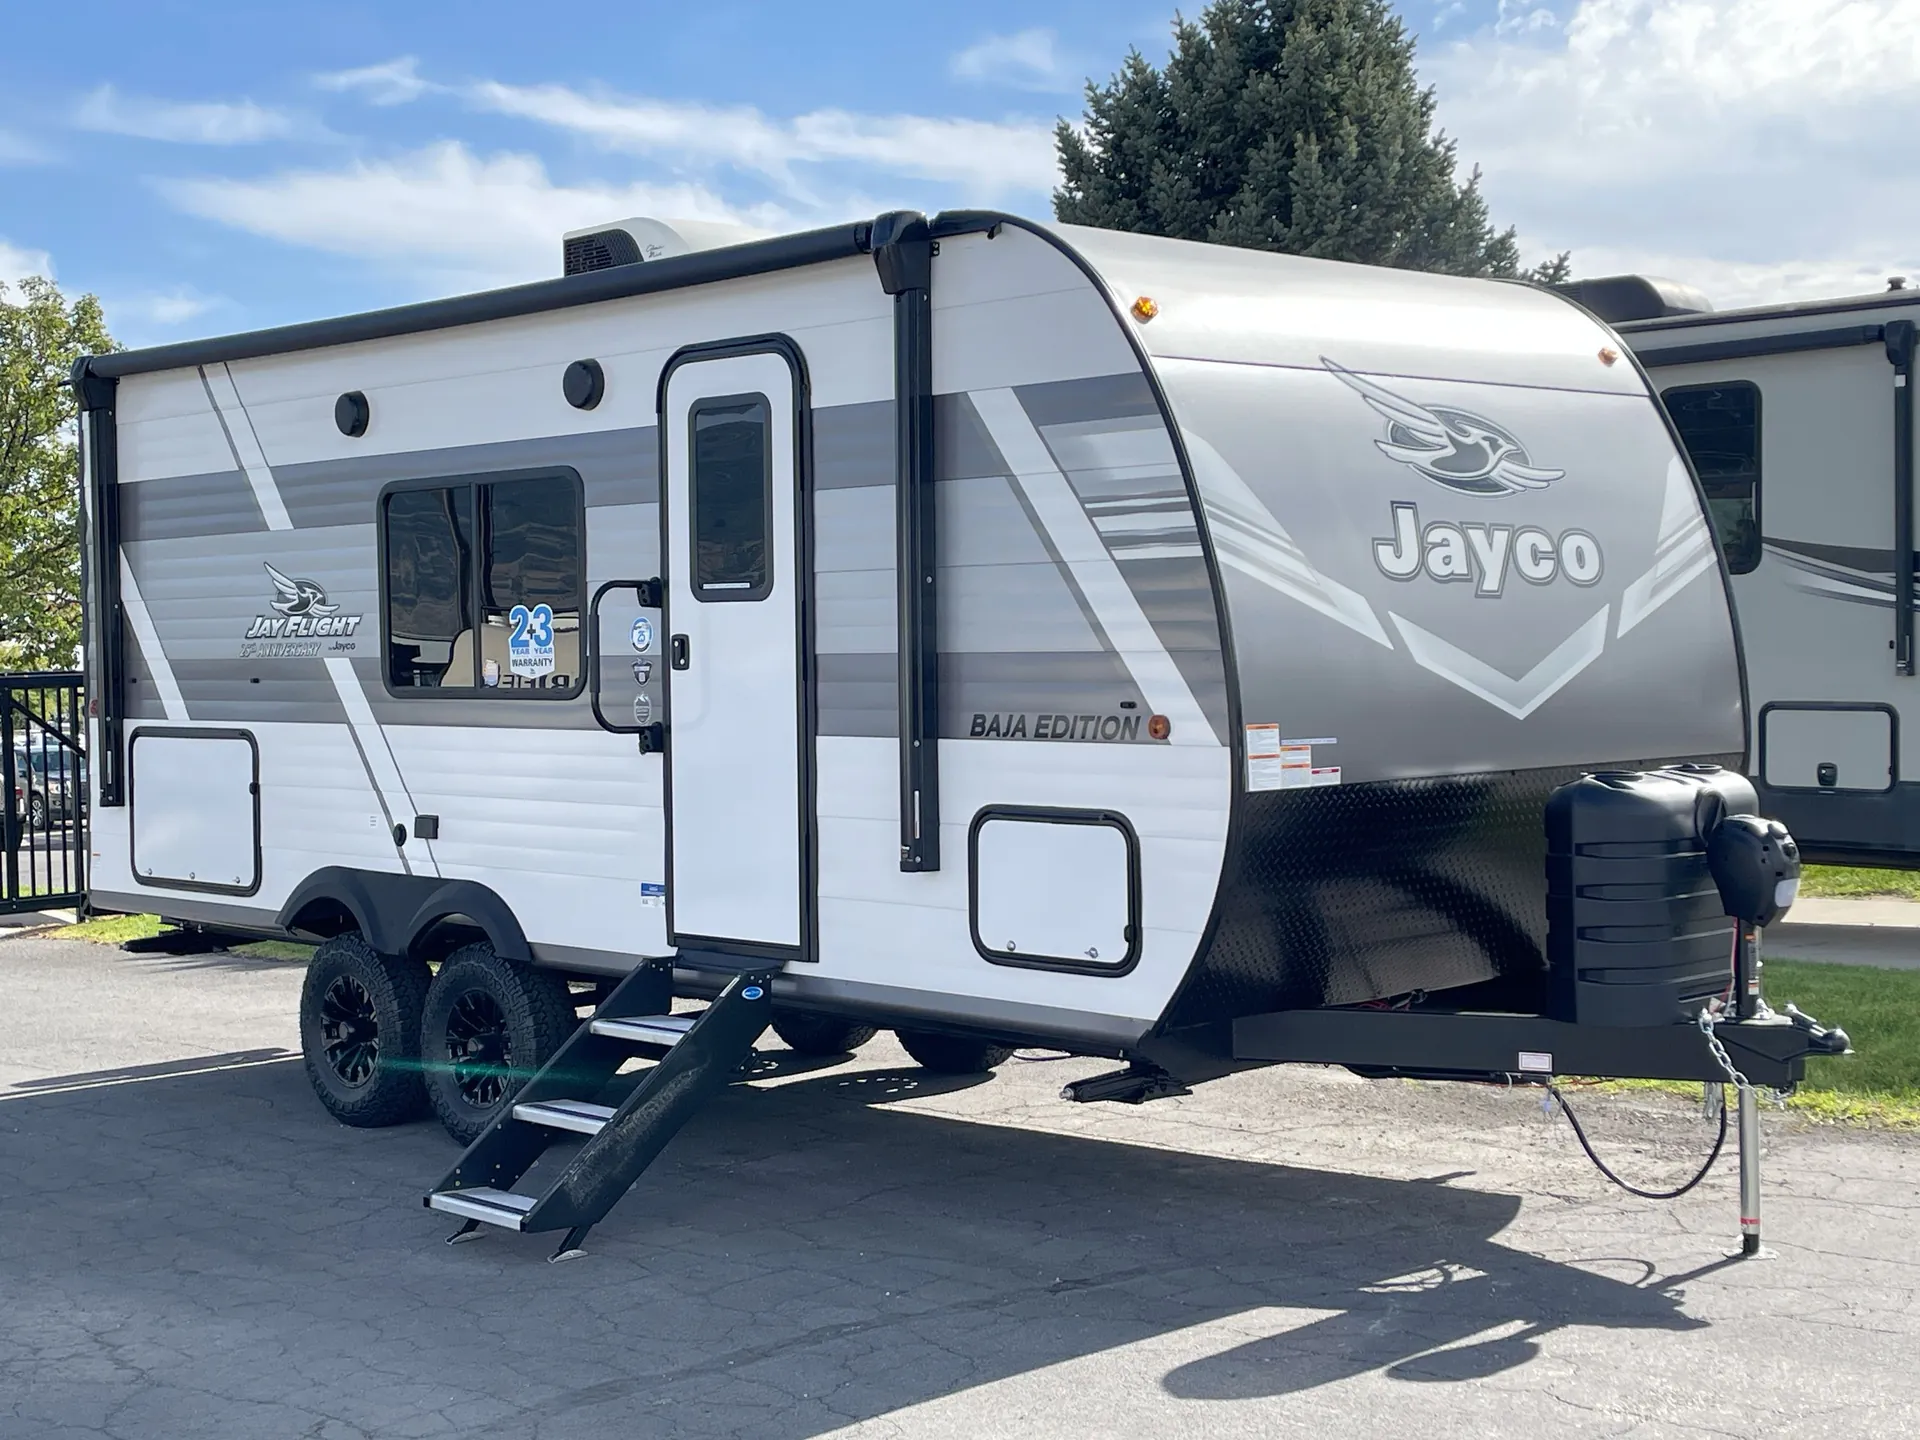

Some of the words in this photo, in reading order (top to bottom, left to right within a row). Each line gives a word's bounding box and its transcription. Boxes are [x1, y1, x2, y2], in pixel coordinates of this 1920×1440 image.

[1372, 500, 1604, 599] Jayco
[245, 614, 285, 639] JAY
[281, 614, 363, 638] FLIGHT
[257, 642, 322, 657] ANNIVERSARY
[333, 641, 356, 652] Jayco
[511, 658, 553, 667] WARRANTY
[970, 714, 1027, 738] BAJA
[1034, 715, 1141, 740] EDITION
